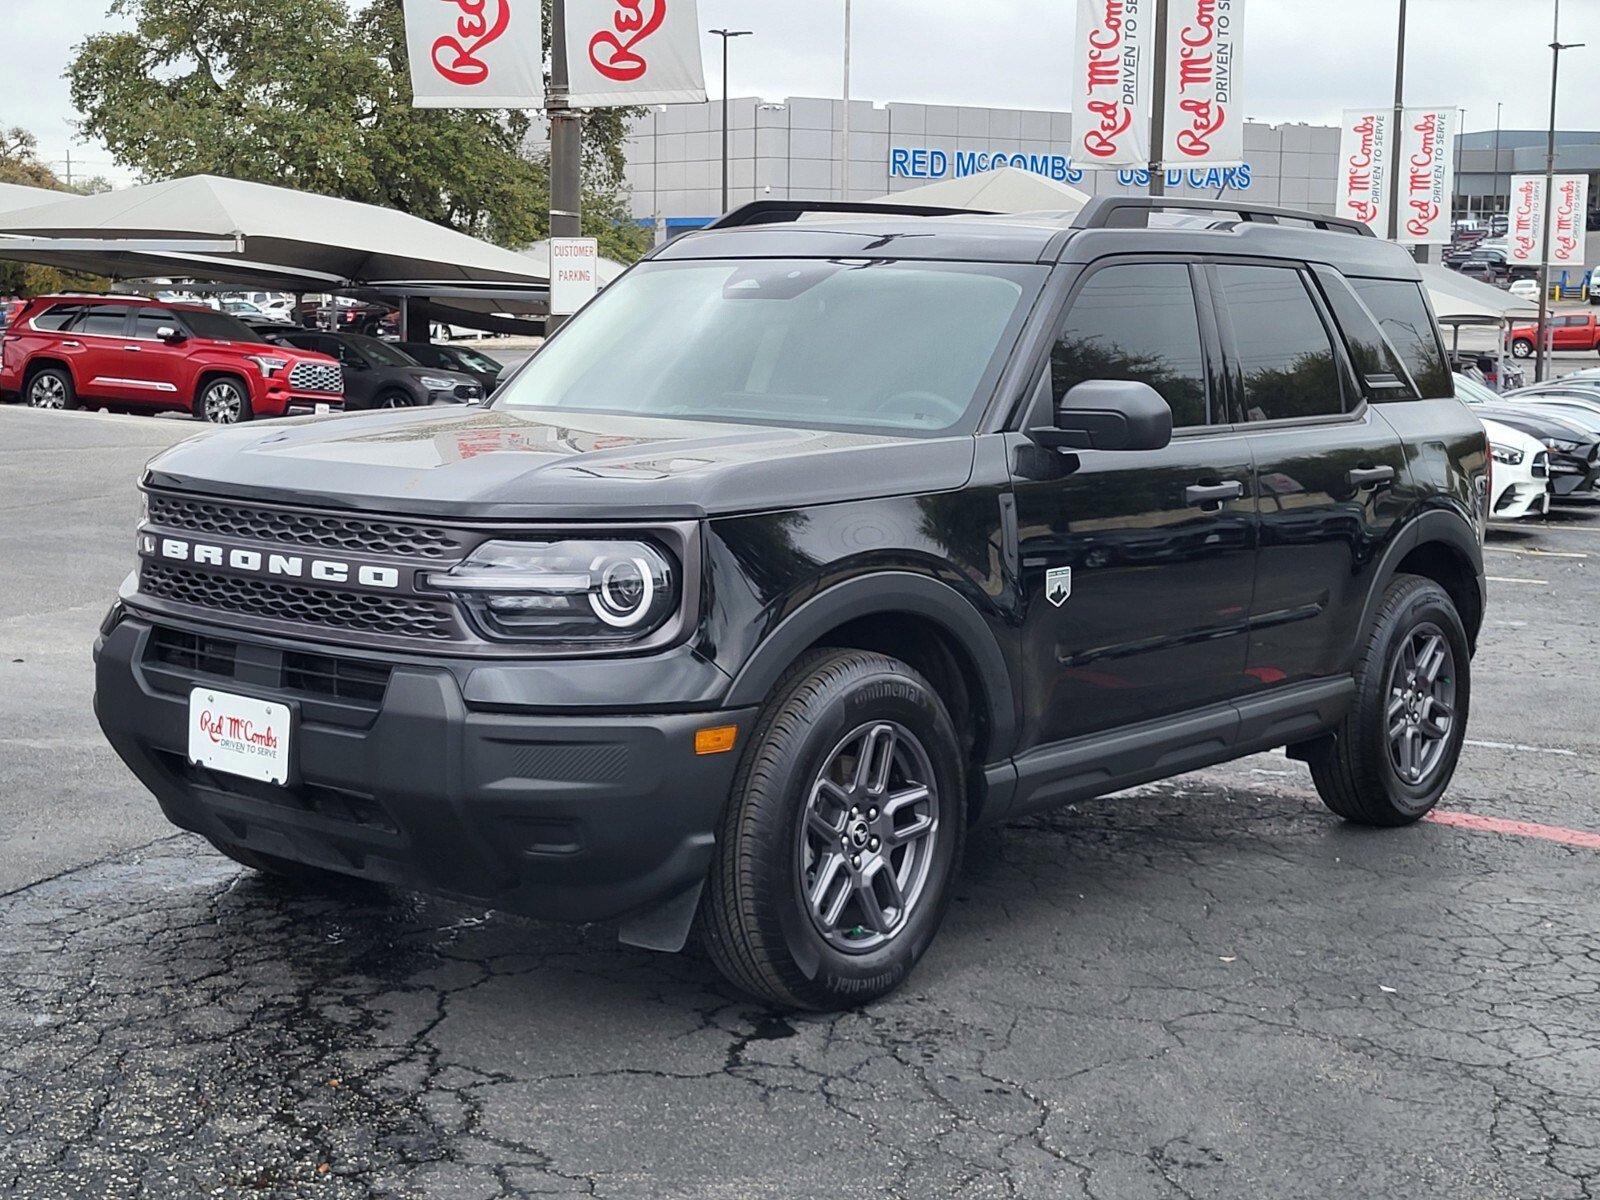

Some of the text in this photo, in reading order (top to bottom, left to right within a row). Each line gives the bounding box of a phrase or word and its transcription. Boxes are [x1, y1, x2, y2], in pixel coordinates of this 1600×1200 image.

[588, 0, 667, 81] Re
[1125, 19, 1137, 41] TO
[1217, 15, 1230, 38] TO
[1123, 46, 1137, 105] DRIVEN
[1216, 43, 1229, 103] DRIVEN
[1084, 100, 1131, 156] Red
[1177, 99, 1224, 156] Red
[891, 149, 947, 178] RED
[1119, 168, 1182, 187] USD
[1189, 164, 1251, 189] CARS
[1347, 115, 1375, 197] McCombs
[1371, 115, 1384, 204] DRIVEN TO SERVE
[1406, 114, 1439, 236] Red McCombs
[1432, 113, 1446, 203] DRIVEN TO SERVE
[554, 246, 595, 257] CUSTOMER
[1513, 236, 1535, 259] Red
[1555, 236, 1577, 259] Red
[558, 270, 591, 281] PARKING
[162, 539, 398, 588] BRONCO
[200, 710, 277, 749] Red McCombs
[221, 739, 277, 759] DRIVEN TO SERVE
